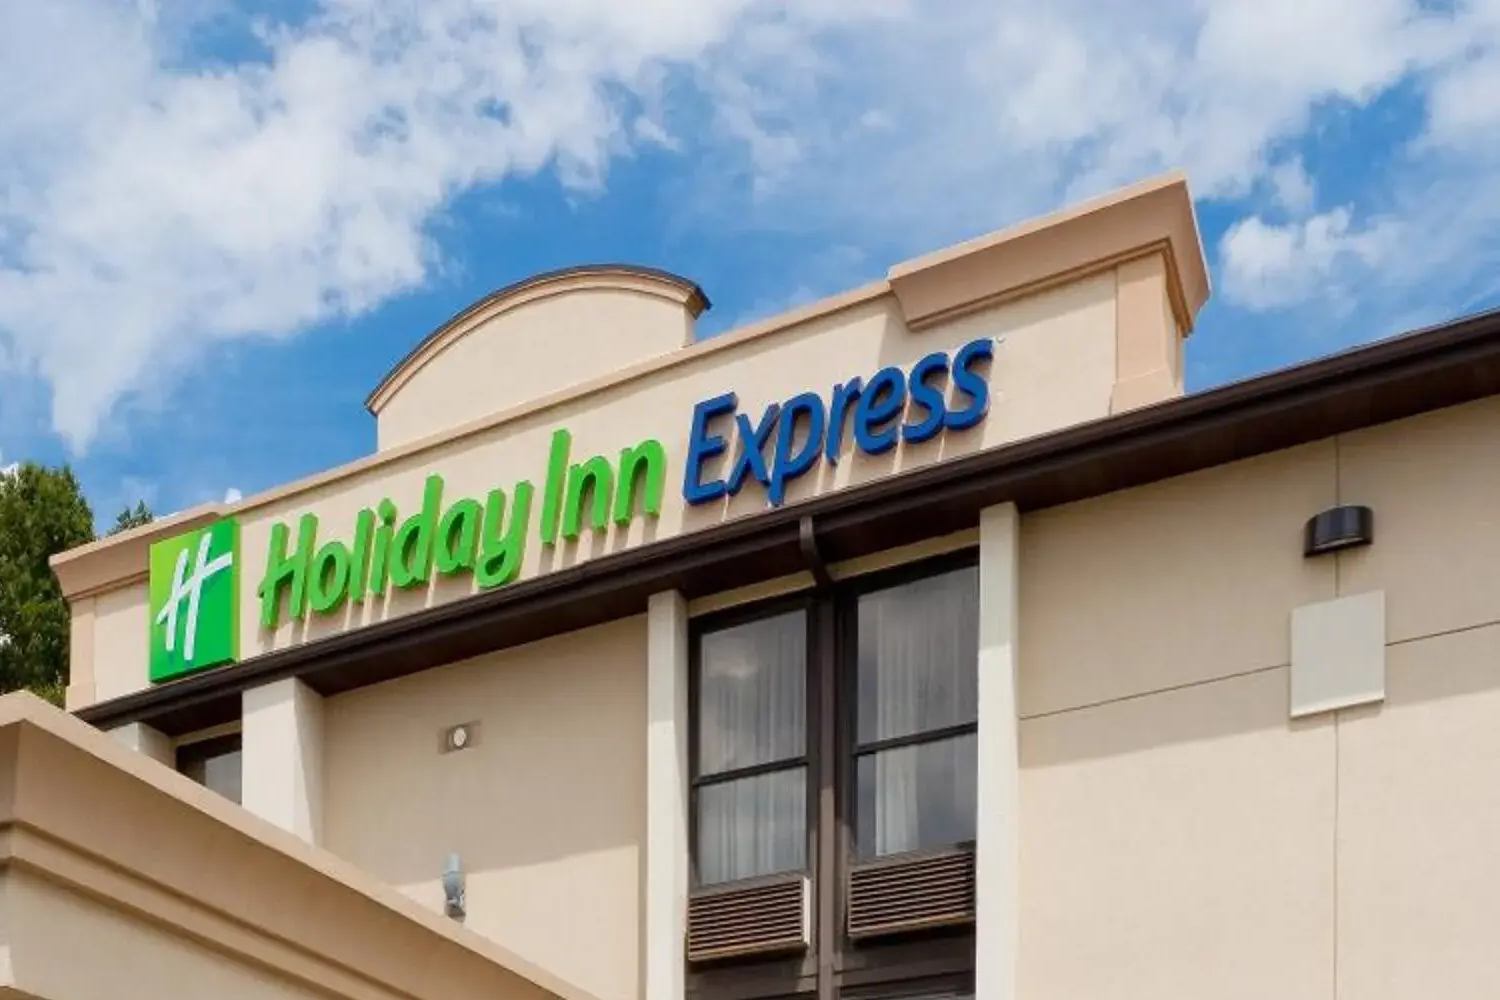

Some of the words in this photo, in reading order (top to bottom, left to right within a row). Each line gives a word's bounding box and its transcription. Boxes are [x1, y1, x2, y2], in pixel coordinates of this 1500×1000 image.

[258, 473, 535, 629] Holiday
[540, 428, 667, 545] Inn
[682, 337, 994, 508] Express
